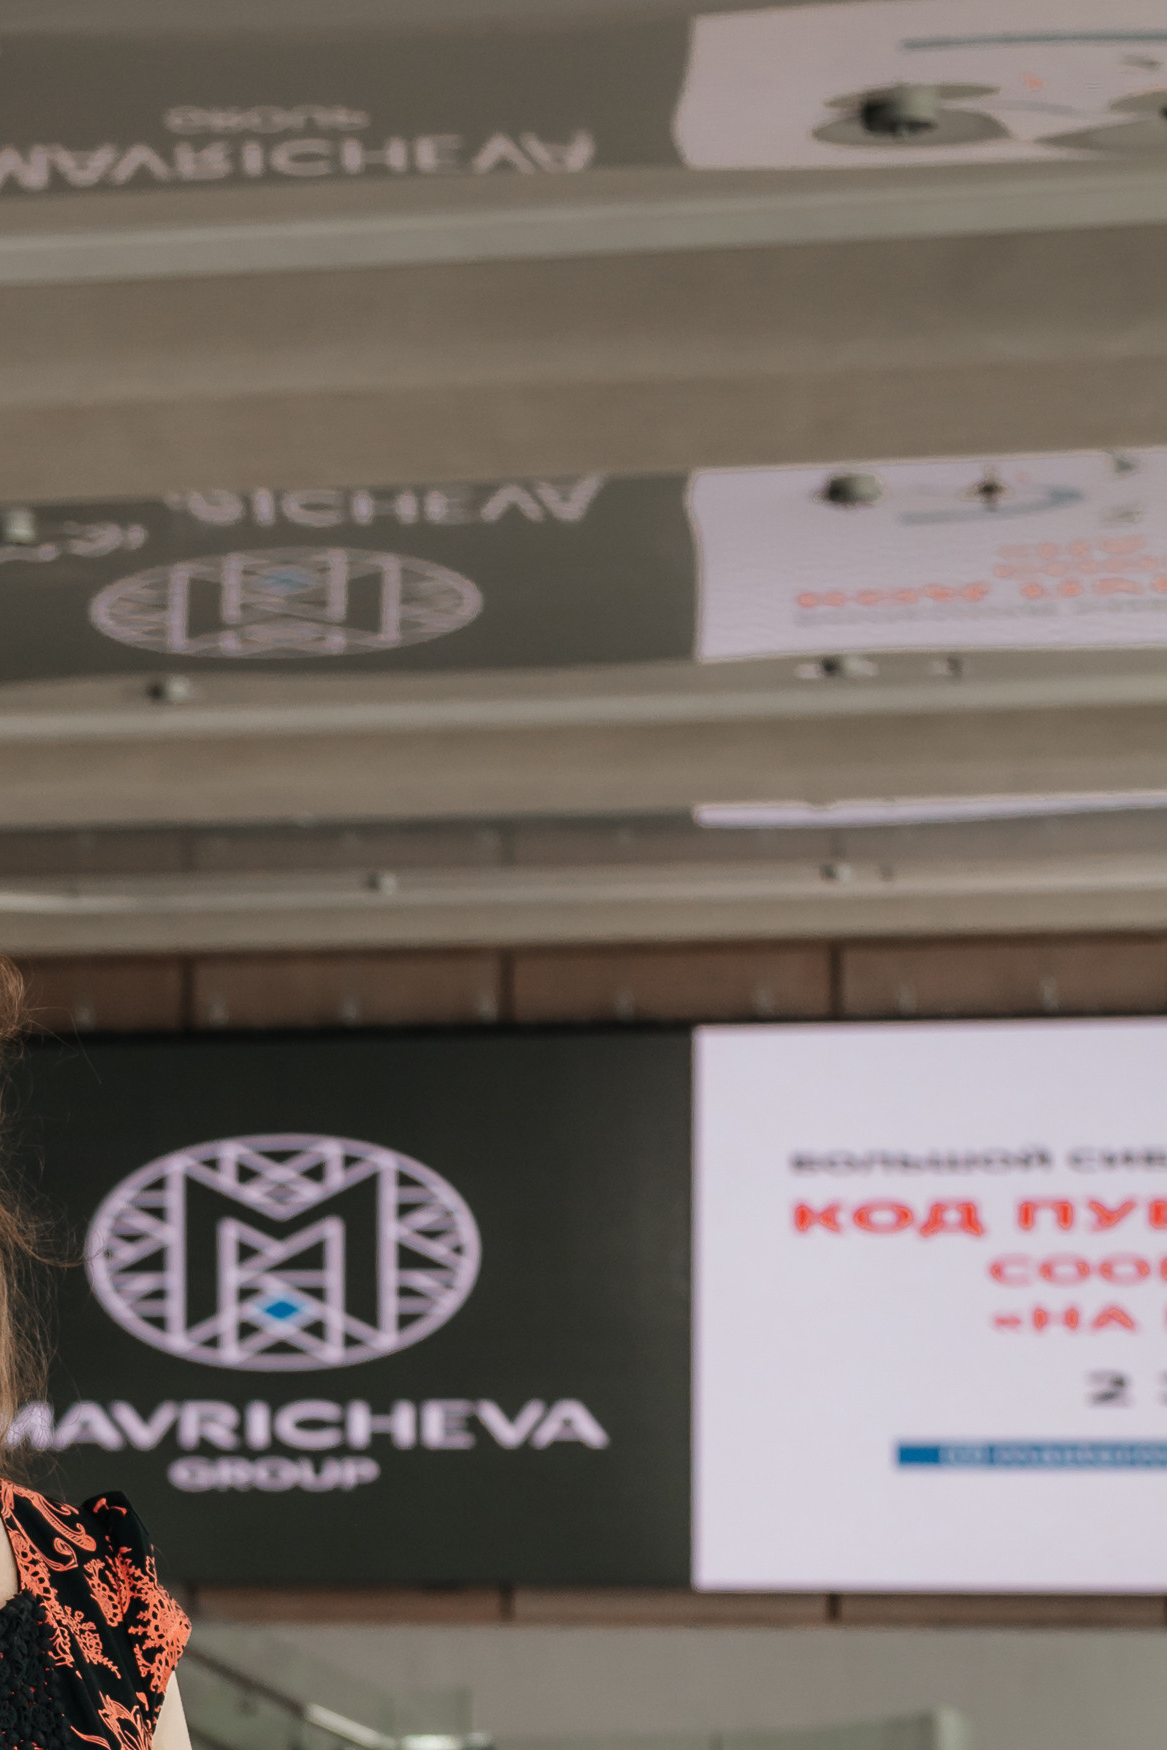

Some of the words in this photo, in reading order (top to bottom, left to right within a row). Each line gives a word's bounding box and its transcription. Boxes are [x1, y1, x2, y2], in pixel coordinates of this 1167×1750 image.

[791, 1198, 986, 1238] КОД
[987, 1253, 1167, 1286] СОО
[167, 1456, 380, 1491] GROUP
